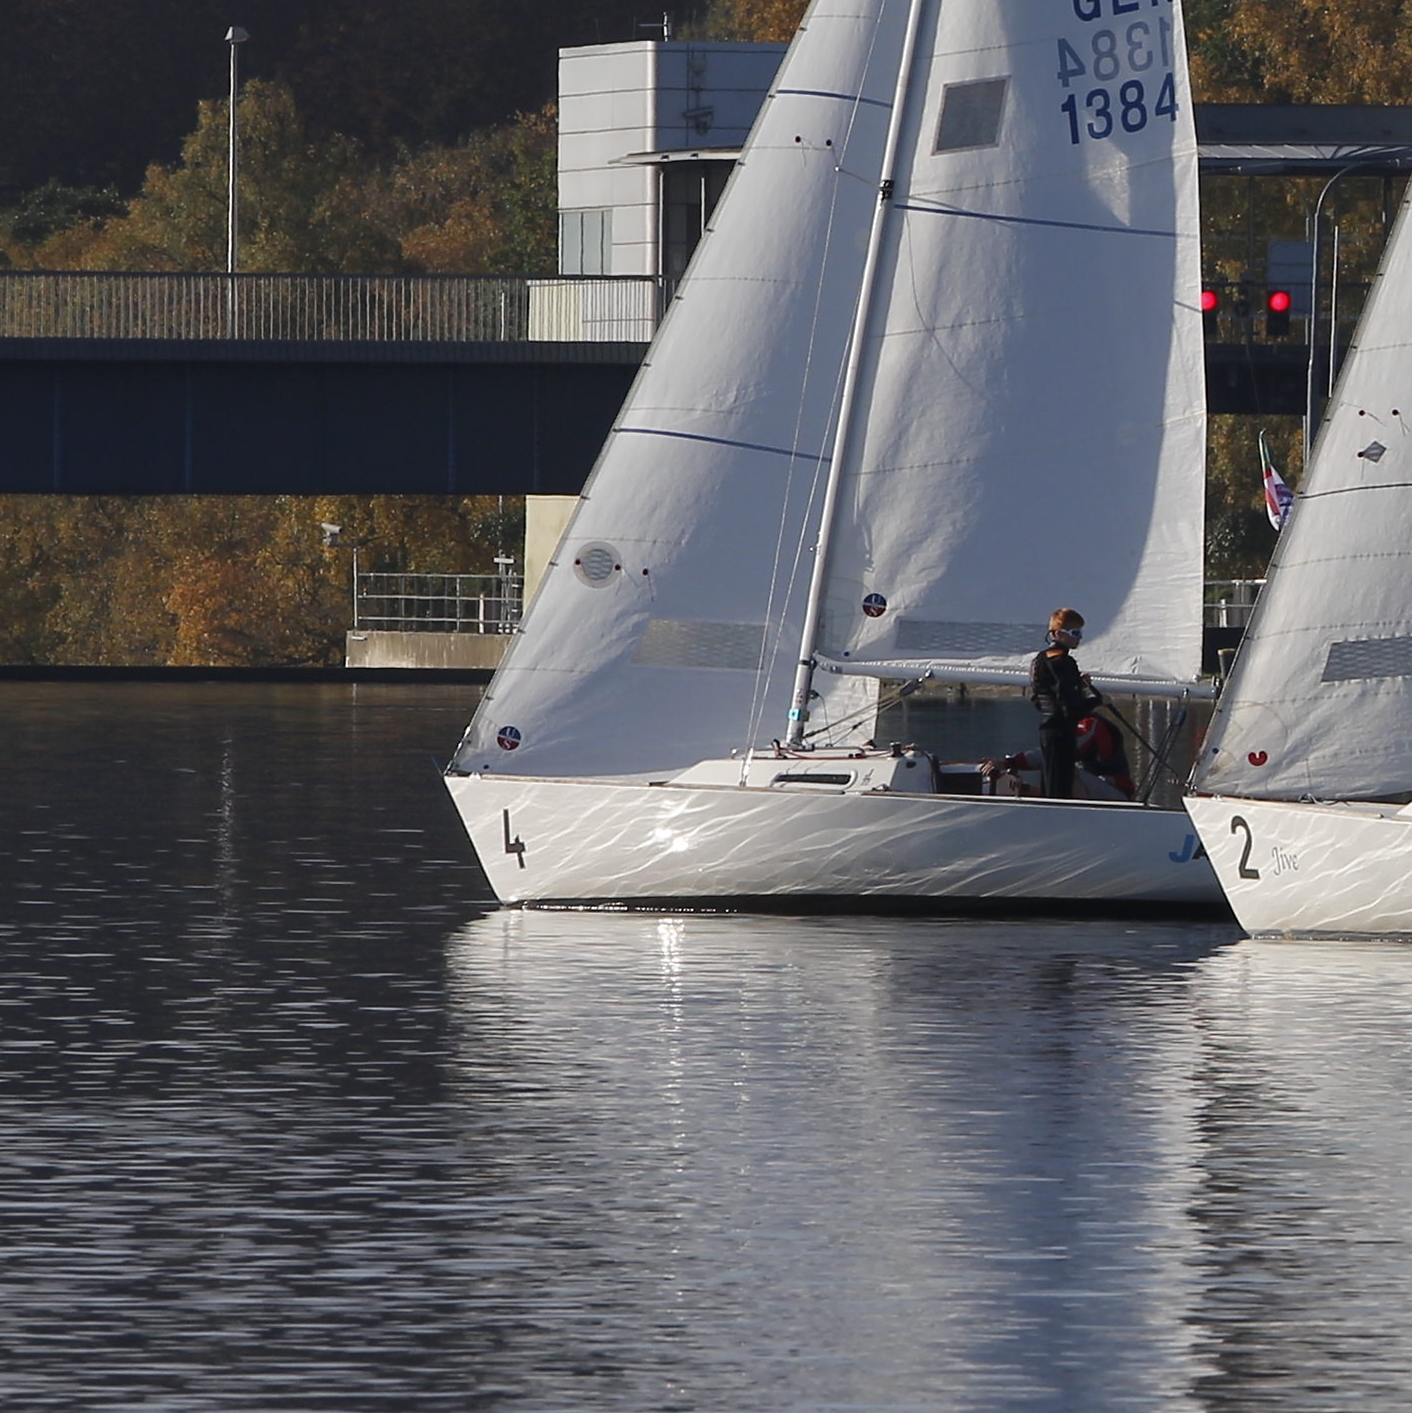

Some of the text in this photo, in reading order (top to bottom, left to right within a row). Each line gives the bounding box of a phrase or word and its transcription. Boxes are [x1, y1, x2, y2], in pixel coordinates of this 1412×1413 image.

[1061, 72, 1180, 145] 1384
[503, 808, 526, 869] 4
[1231, 815, 1260, 880] 2
[1271, 846, 1300, 876] Jive
